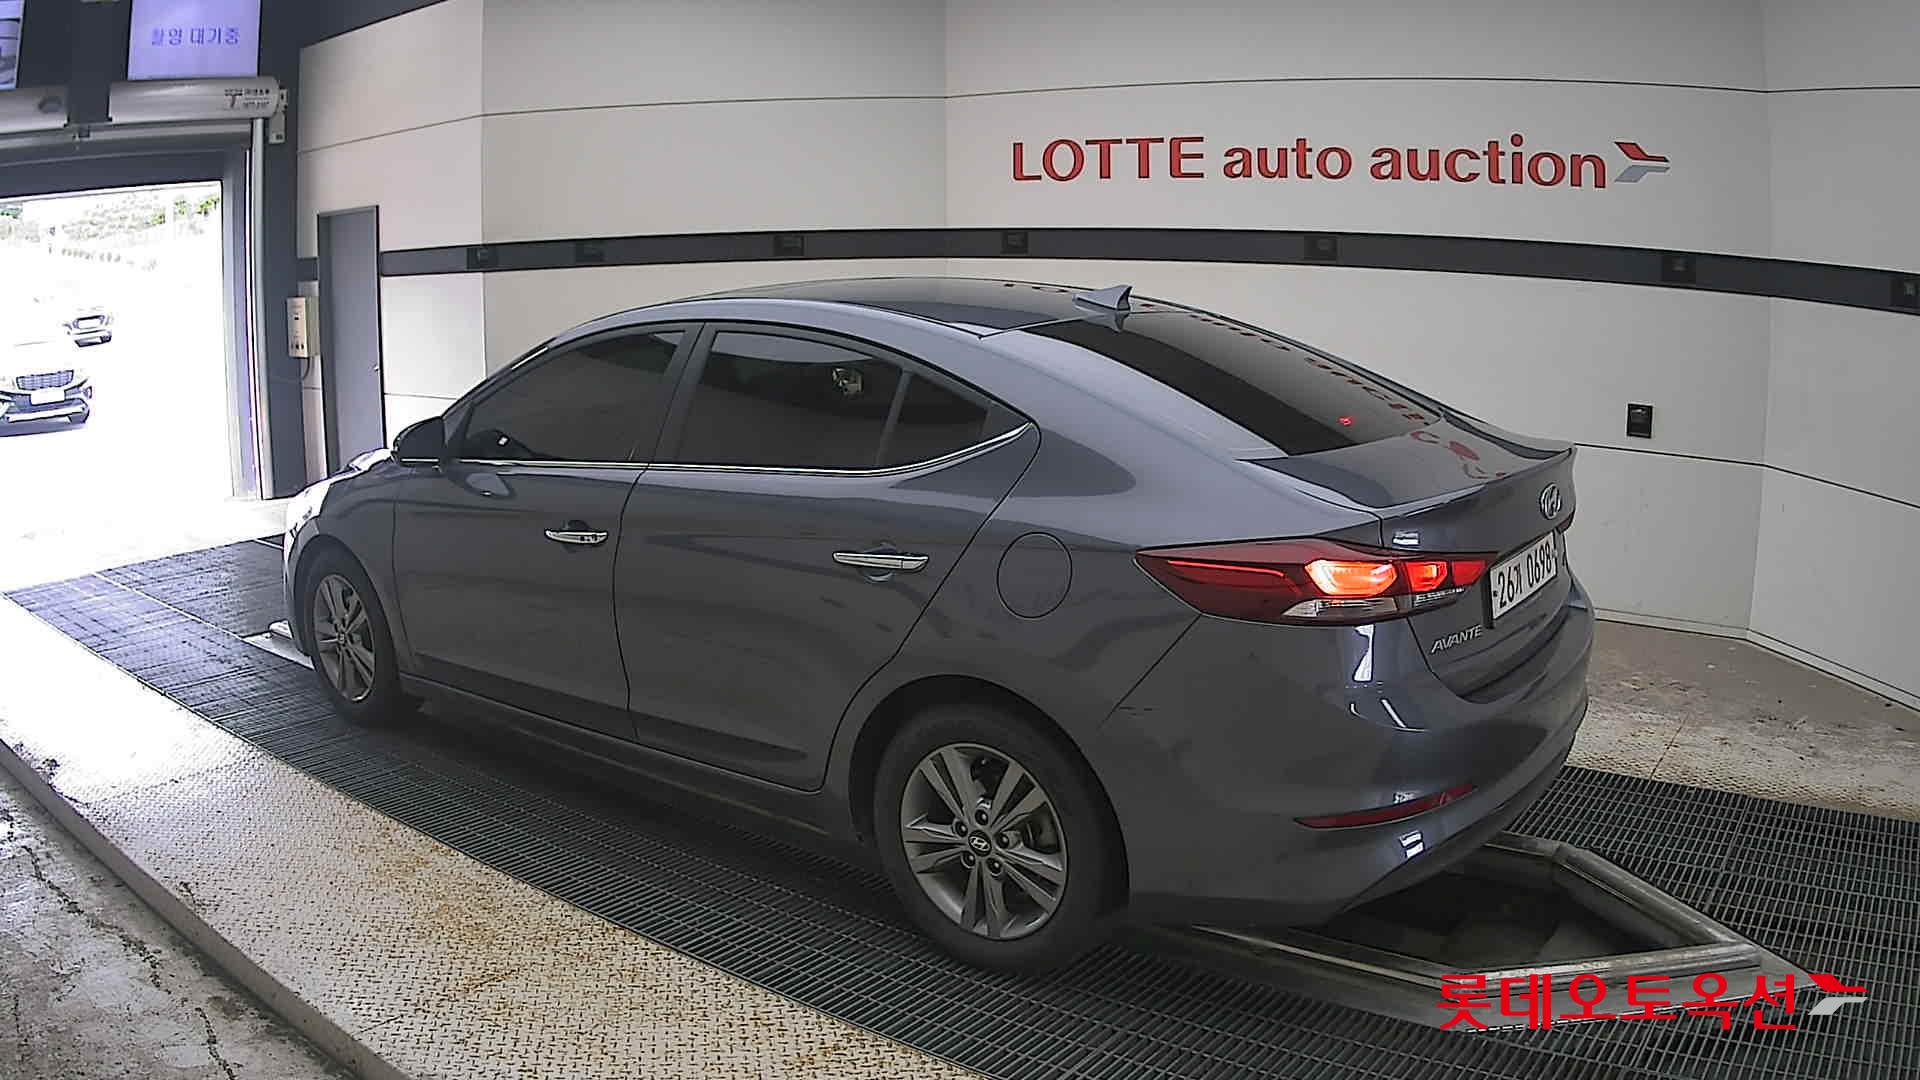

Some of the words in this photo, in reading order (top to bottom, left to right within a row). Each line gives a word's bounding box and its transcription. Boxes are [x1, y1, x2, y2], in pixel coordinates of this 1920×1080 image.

[1012, 136, 1206, 183] LOTTE
[1222, 138, 1353, 181] auto
[1368, 134, 1607, 189] auction
[1526, 540, 1552, 588] 0698
[1431, 622, 1483, 654] AVANTE
